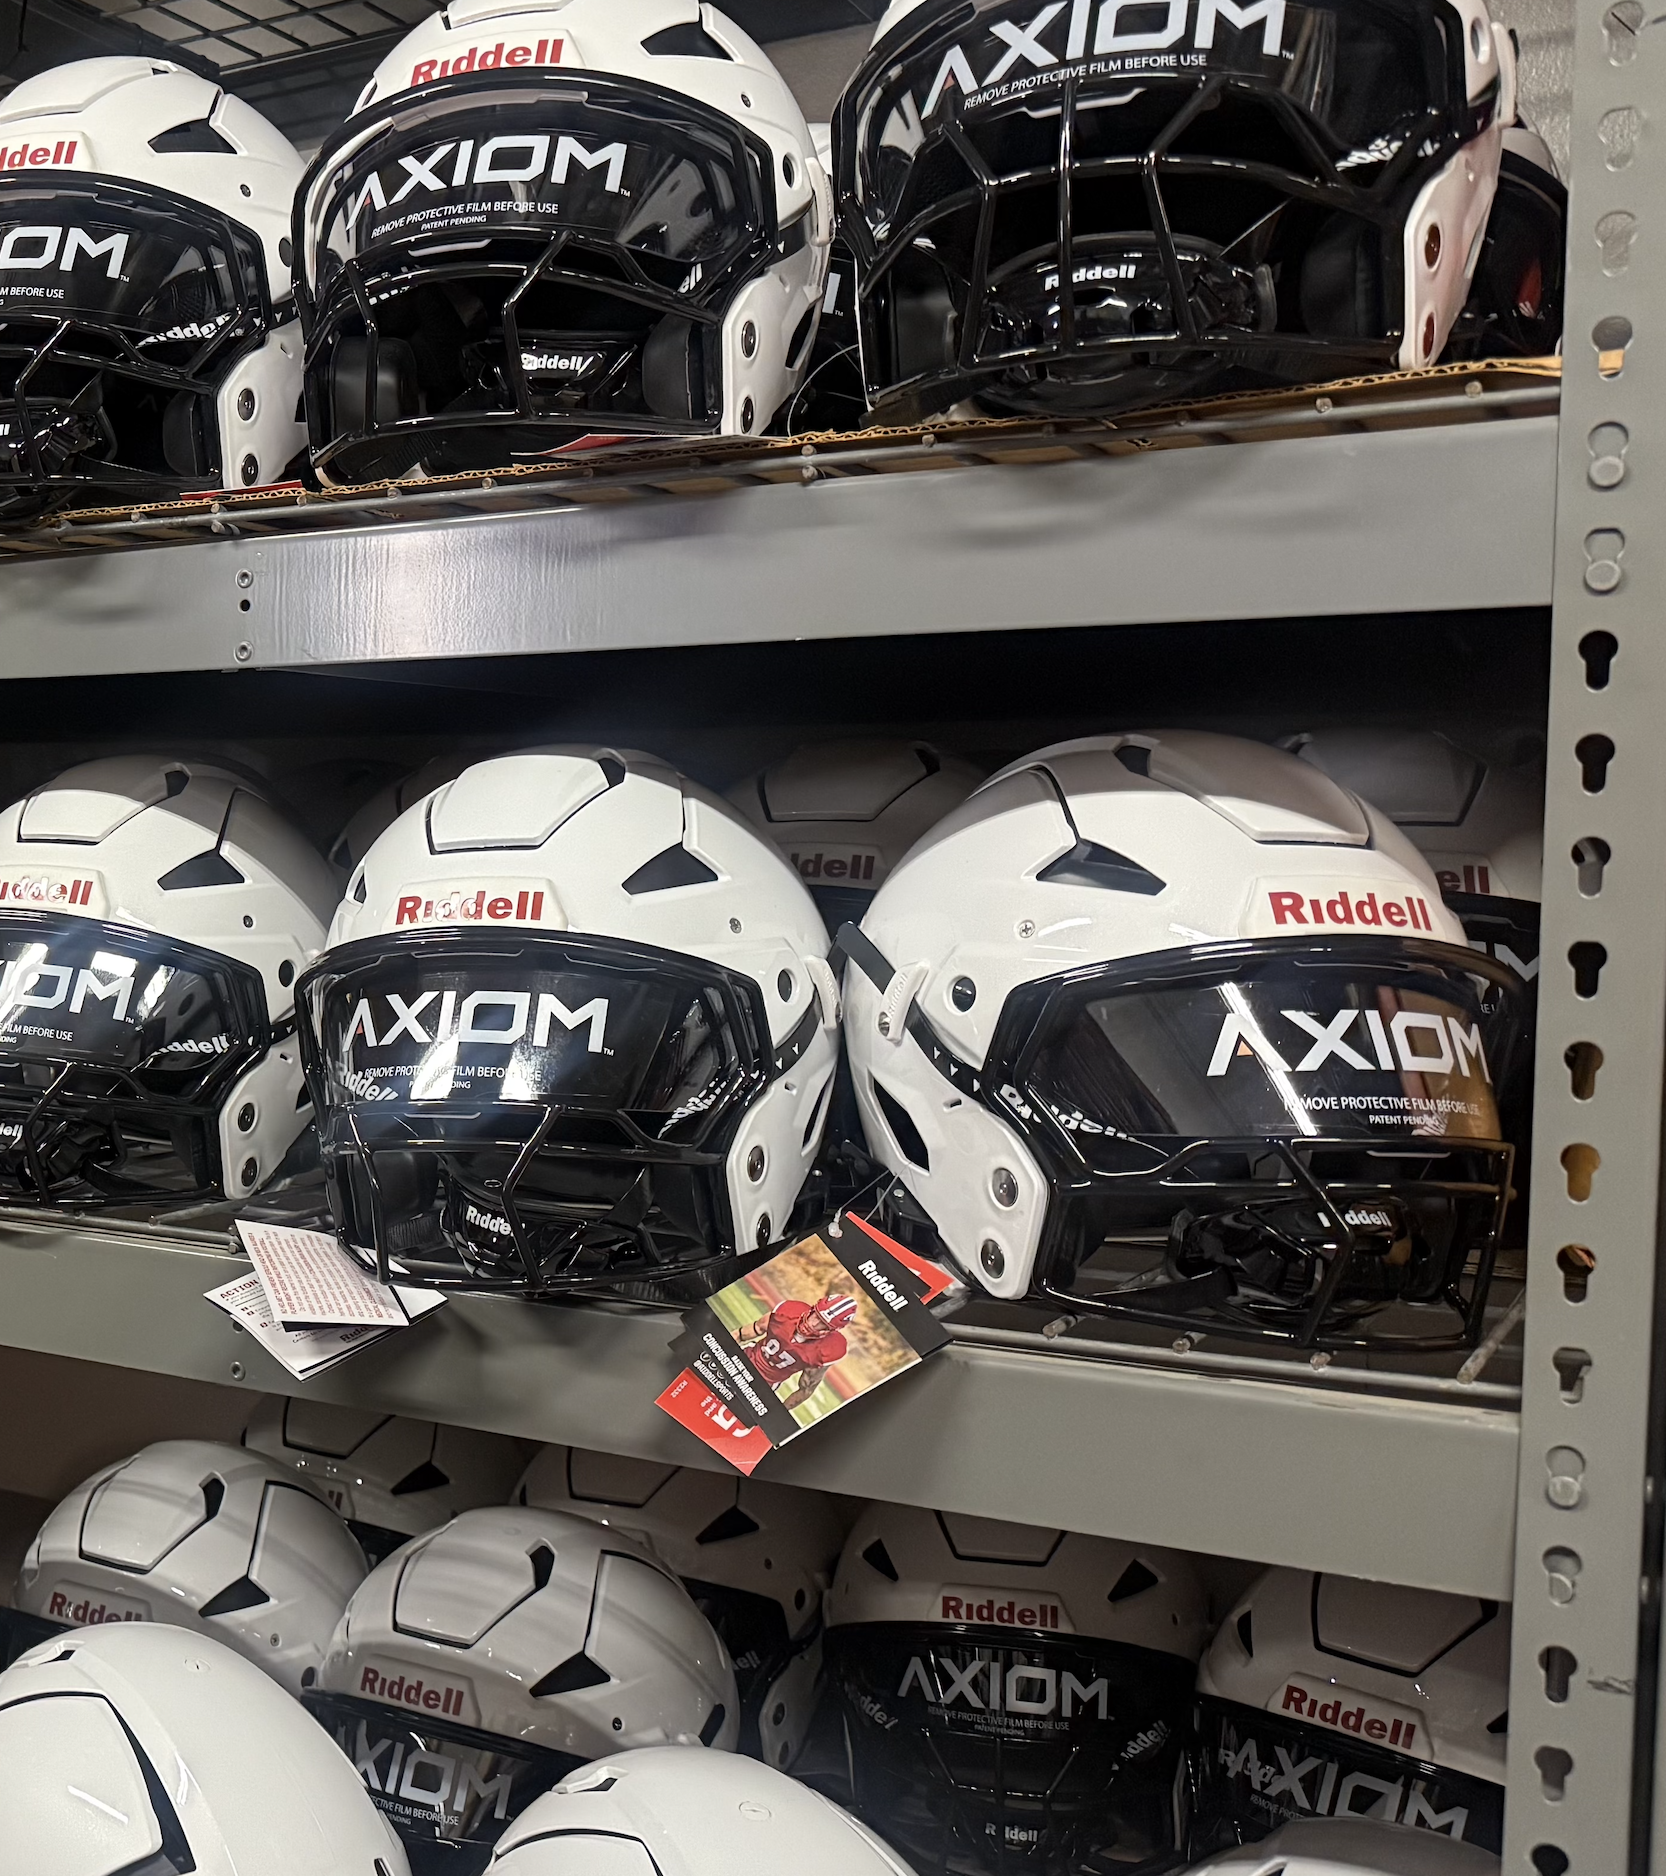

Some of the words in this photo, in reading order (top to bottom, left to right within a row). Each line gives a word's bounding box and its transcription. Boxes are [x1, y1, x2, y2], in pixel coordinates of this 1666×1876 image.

[410, 39, 564, 86] Riddell
[921, 0, 1286, 120] AXIOM
[964, 83, 1009, 110] REMOVE
[1012, 64, 1086, 92] PROTECTIVE
[1089, 58, 1121, 74] FILM
[1124, 54, 1177, 69] BEFORE
[1180, 53, 1207, 67] USE
[345, 135, 628, 230] AXIOM
[371, 215, 405, 239] REMOVE
[406, 204, 465, 228] PROTECTIVE
[466, 202, 491, 214] FILM
[493, 201, 535, 213] BEFORE
[537, 202, 559, 215] USE
[421, 218, 448, 231] PATENT
[449, 215, 487, 228] PENDING
[10, 286, 44, 299] BEFORE
[45, 288, 65, 299] USE
[1045, 265, 1137, 291] Rddell
[791, 853, 875, 881] dell
[395, 890, 544, 925] Riddell
[1268, 891, 1432, 934] Riddell
[5, 1023, 22, 1034] FILM
[23, 1026, 55, 1039] BEFORE
[55, 1030, 73, 1041] USE
[342, 991, 610, 1053] AXIOM
[1206, 1009, 1491, 1082] AXIOM
[364, 1065, 394, 1078] REMOVE
[1285, 1095, 1340, 1111] MOVE
[1341, 1095, 1411, 1111] PROTECTIVE
[1369, 1113, 1402, 1125] PATENT
[466, 1205, 517, 1237] Ridde
[1318, 1210, 1392, 1227] ddell
[857, 1259, 909, 1312] Riddell
[702, 1332, 738, 1381] CONCUSSION
[733, 1371, 769, 1417] AWARENESS
[941, 1595, 1059, 1629] Riddell
[360, 1665, 464, 1718] Riddell
[897, 1656, 1108, 1720] AXIOM
[957, 1711, 1004, 1726] PROTECTIVE
[1023, 1718, 1052, 1730] BEFORE
[1054, 1721, 1070, 1731] USE
[1282, 1684, 1416, 1752] Riddell
[1234, 1738, 1470, 1841] AXIOM
[371, 1795, 394, 1811] ECTIVE
[394, 1803, 412, 1816] FILM
[413, 1808, 443, 1823] BEFORE
[985, 1822, 1038, 1843] Rdell
